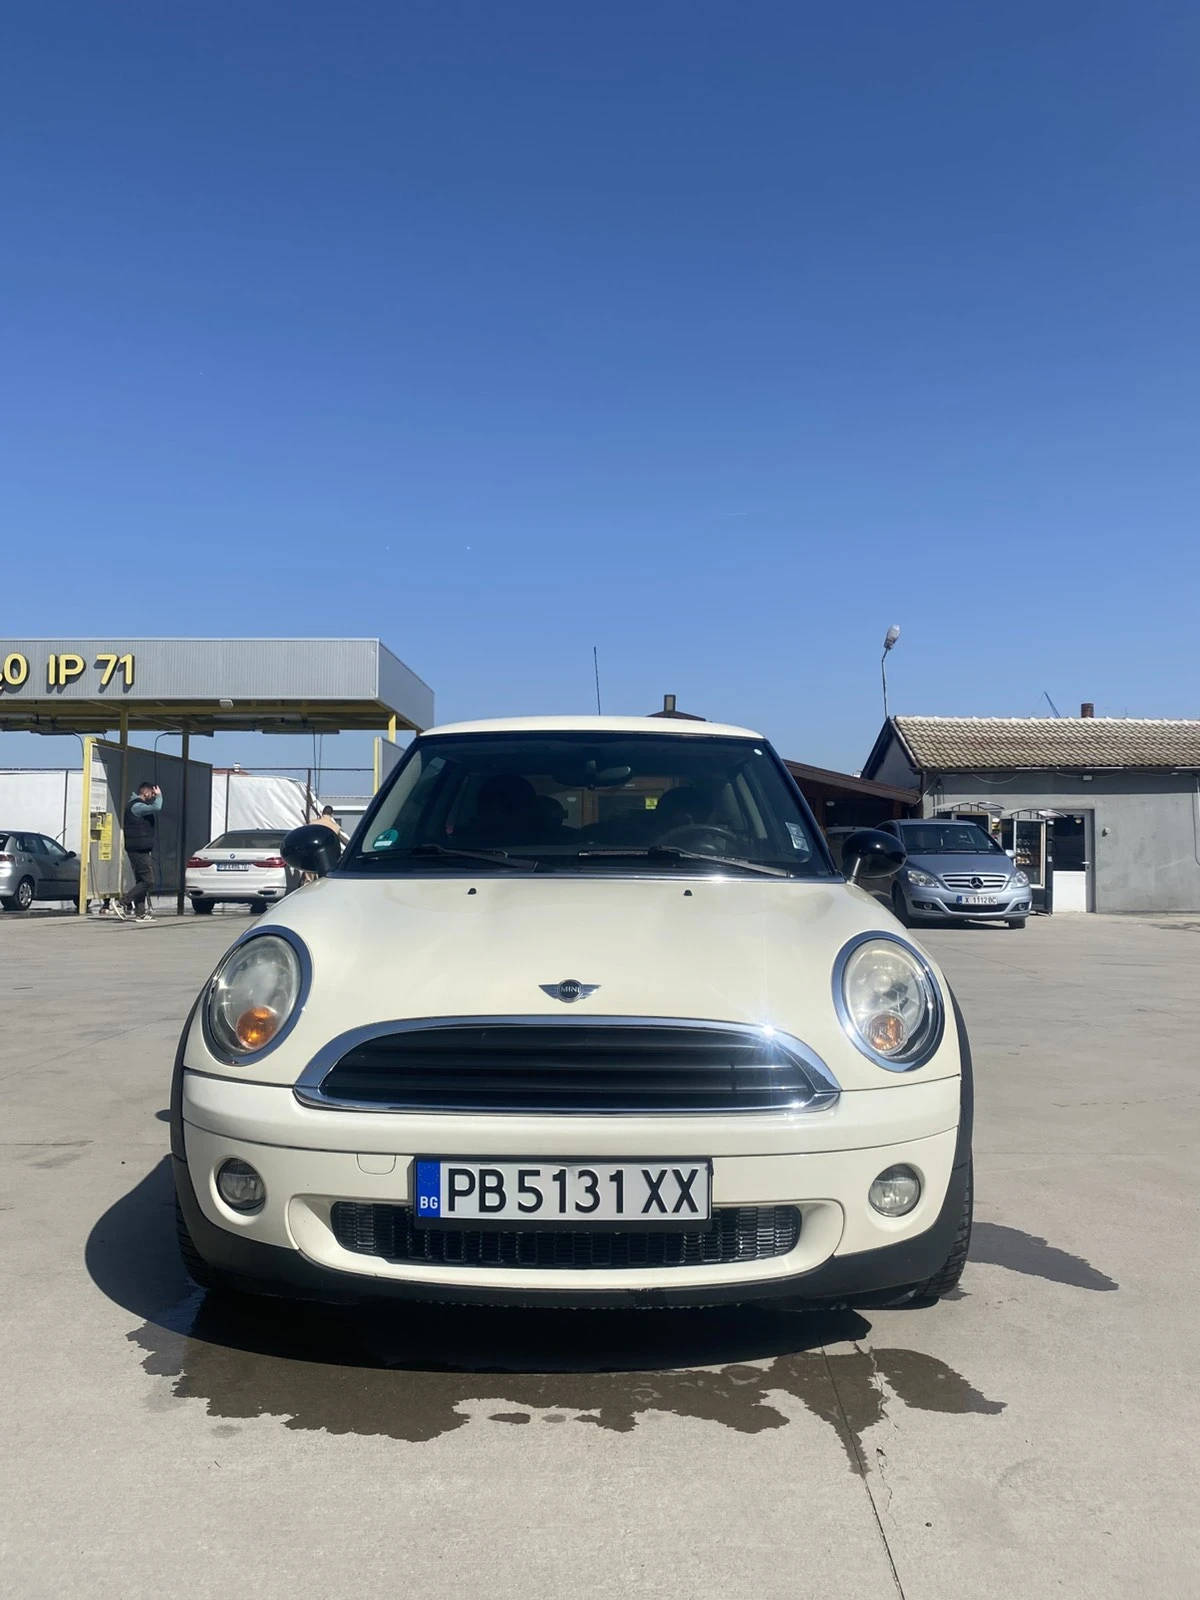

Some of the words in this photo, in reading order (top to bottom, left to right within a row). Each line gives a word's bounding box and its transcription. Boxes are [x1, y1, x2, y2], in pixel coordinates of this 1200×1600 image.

[48, 653, 85, 685] IP
[96, 653, 133, 685] 71
[420, 1196, 438, 1209] BG
[448, 1168, 507, 1213] PB
[517, 1168, 624, 1213] 5131
[641, 1168, 699, 1213] XX
